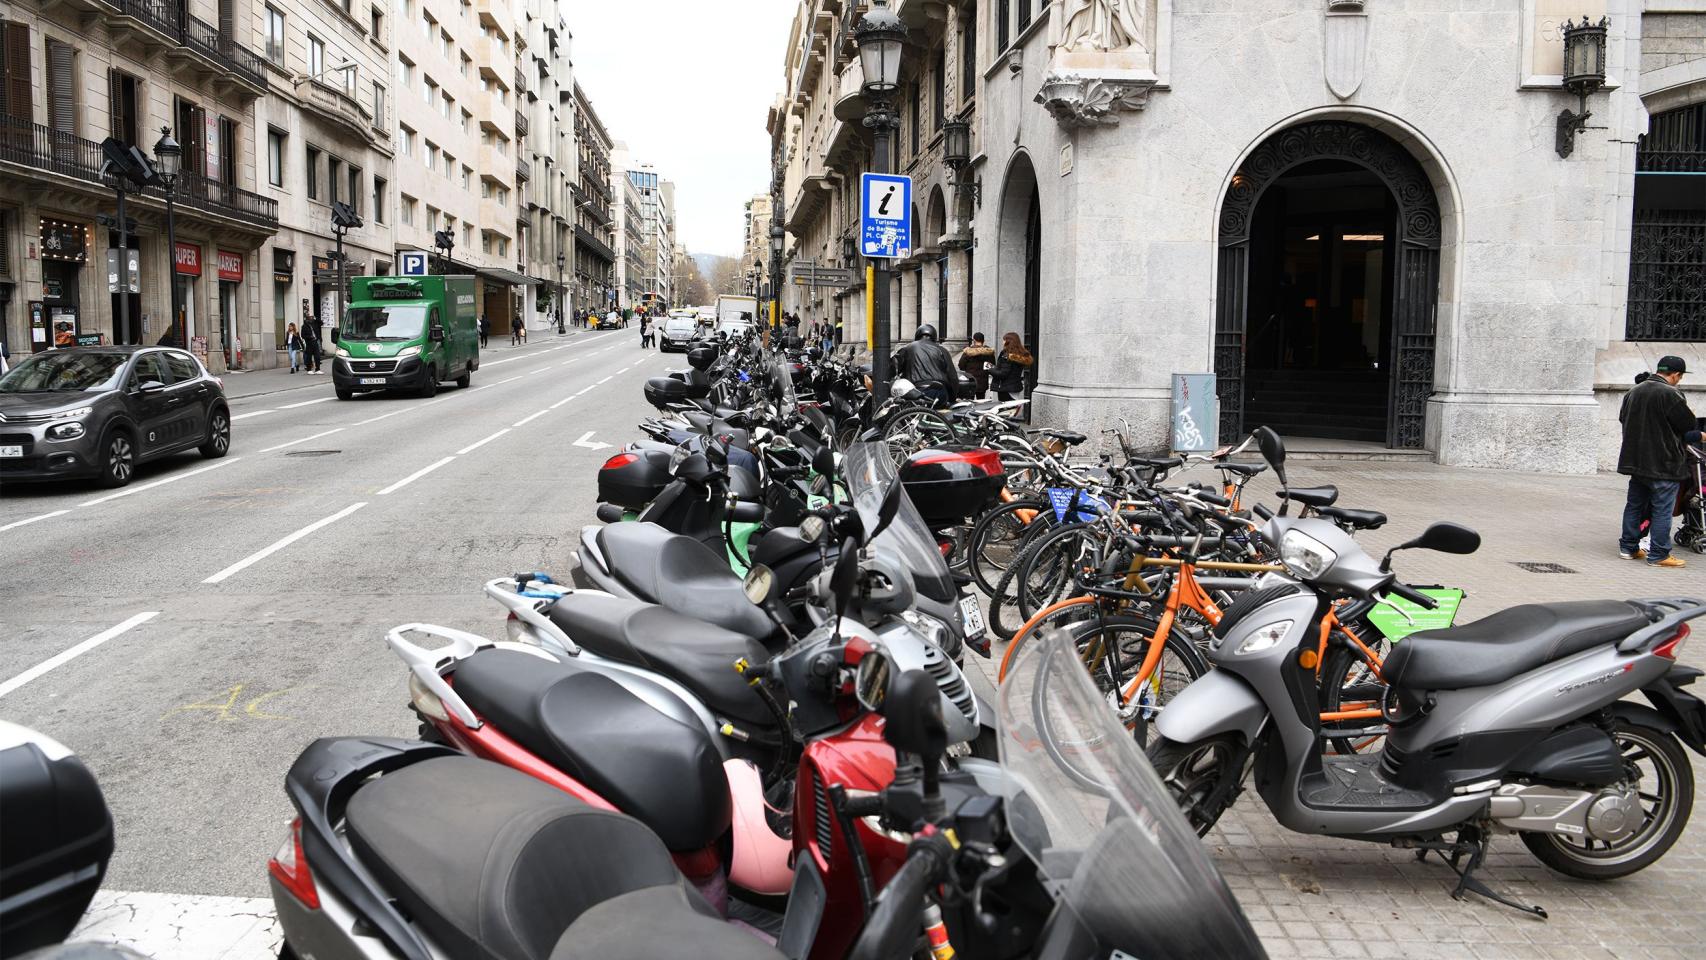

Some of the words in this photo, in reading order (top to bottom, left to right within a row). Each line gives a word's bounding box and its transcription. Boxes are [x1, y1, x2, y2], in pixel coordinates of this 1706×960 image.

[876, 233, 906, 241] Canya
[407, 256, 421, 273] P
[373, 289, 423, 299] MERCADONA
